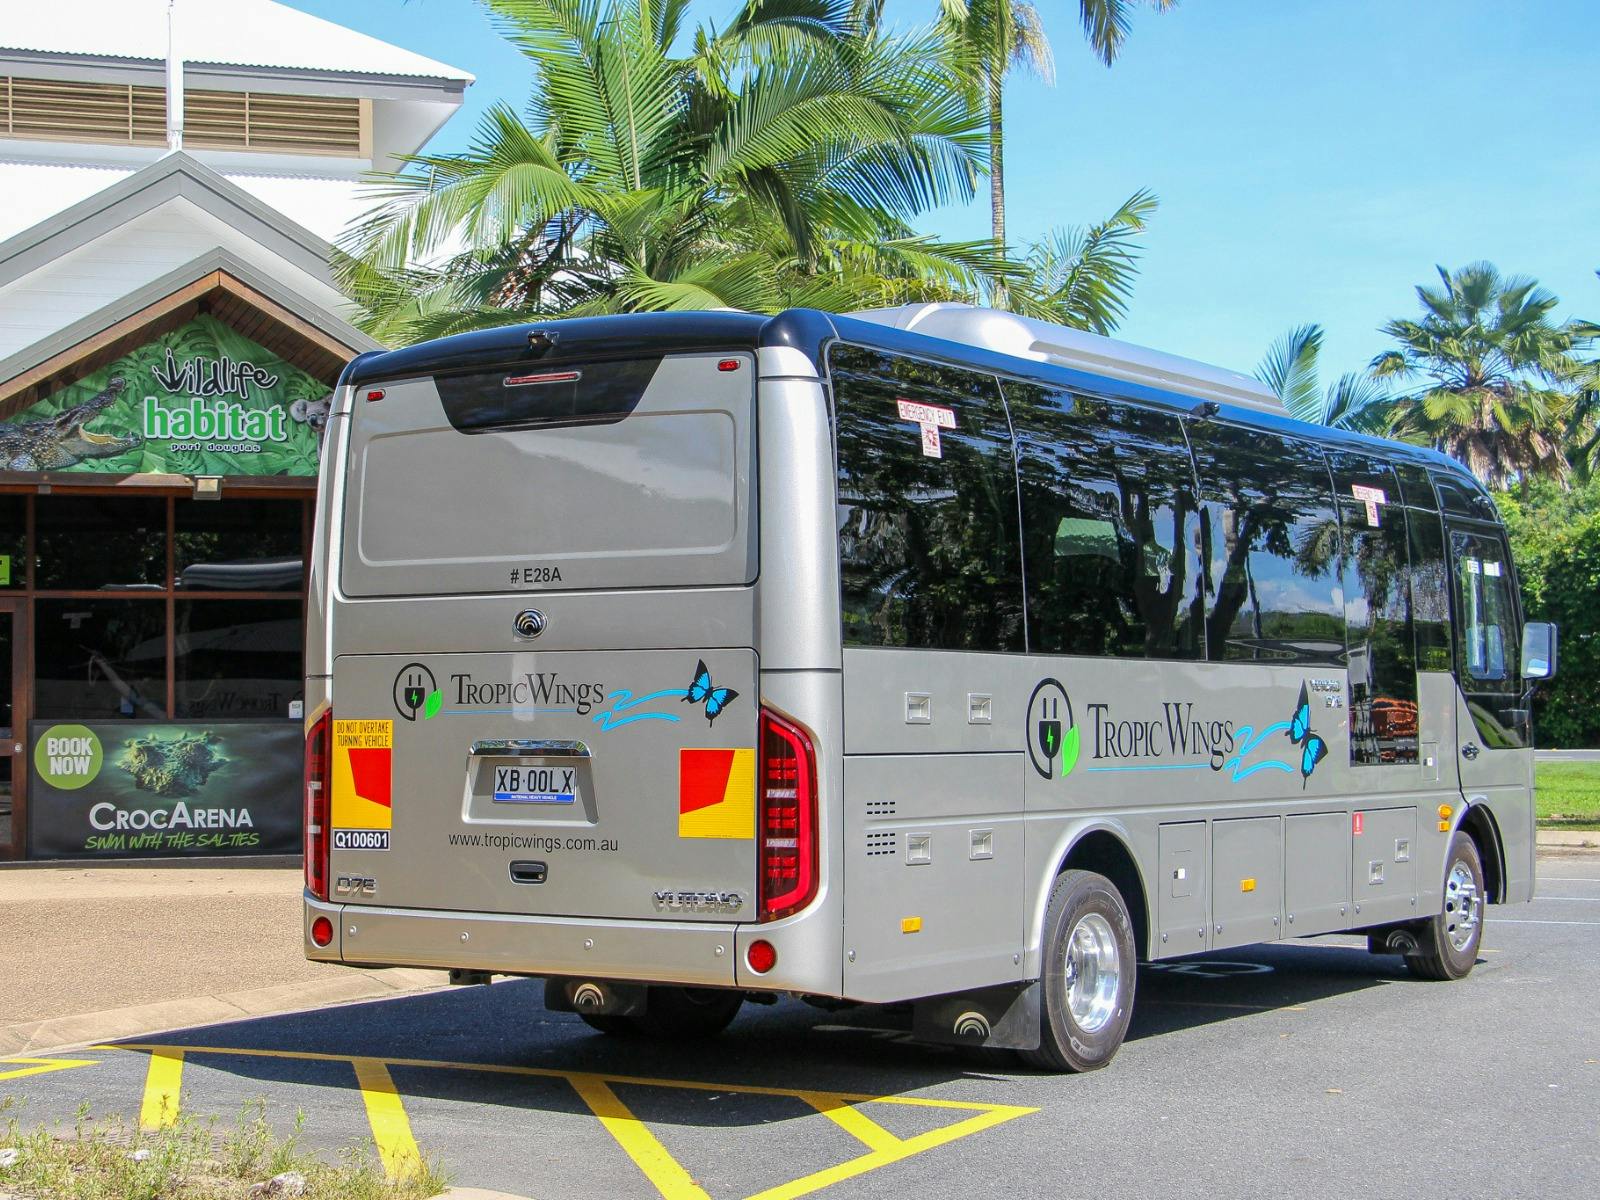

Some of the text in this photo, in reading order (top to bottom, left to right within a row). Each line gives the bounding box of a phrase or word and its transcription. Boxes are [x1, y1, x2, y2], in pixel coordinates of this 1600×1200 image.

[152, 348, 279, 399] Wildlife
[143, 396, 288, 442] habitat
[171, 443, 262, 454] port douglas
[510, 567, 562, 583] # E28A
[336, 721, 389, 733] DO NOT OVERTAKE
[47, 737, 93, 756] BOOK
[337, 734, 388, 747] TURNING VEHICLE
[50, 756, 91, 776] NOW
[85, 834, 125, 849] SWIM
[129, 832, 162, 849] WITH
[165, 832, 194, 848] THE
[335, 832, 388, 848] Q100601
[449, 832, 618, 853] www.tropicwings.com.au
